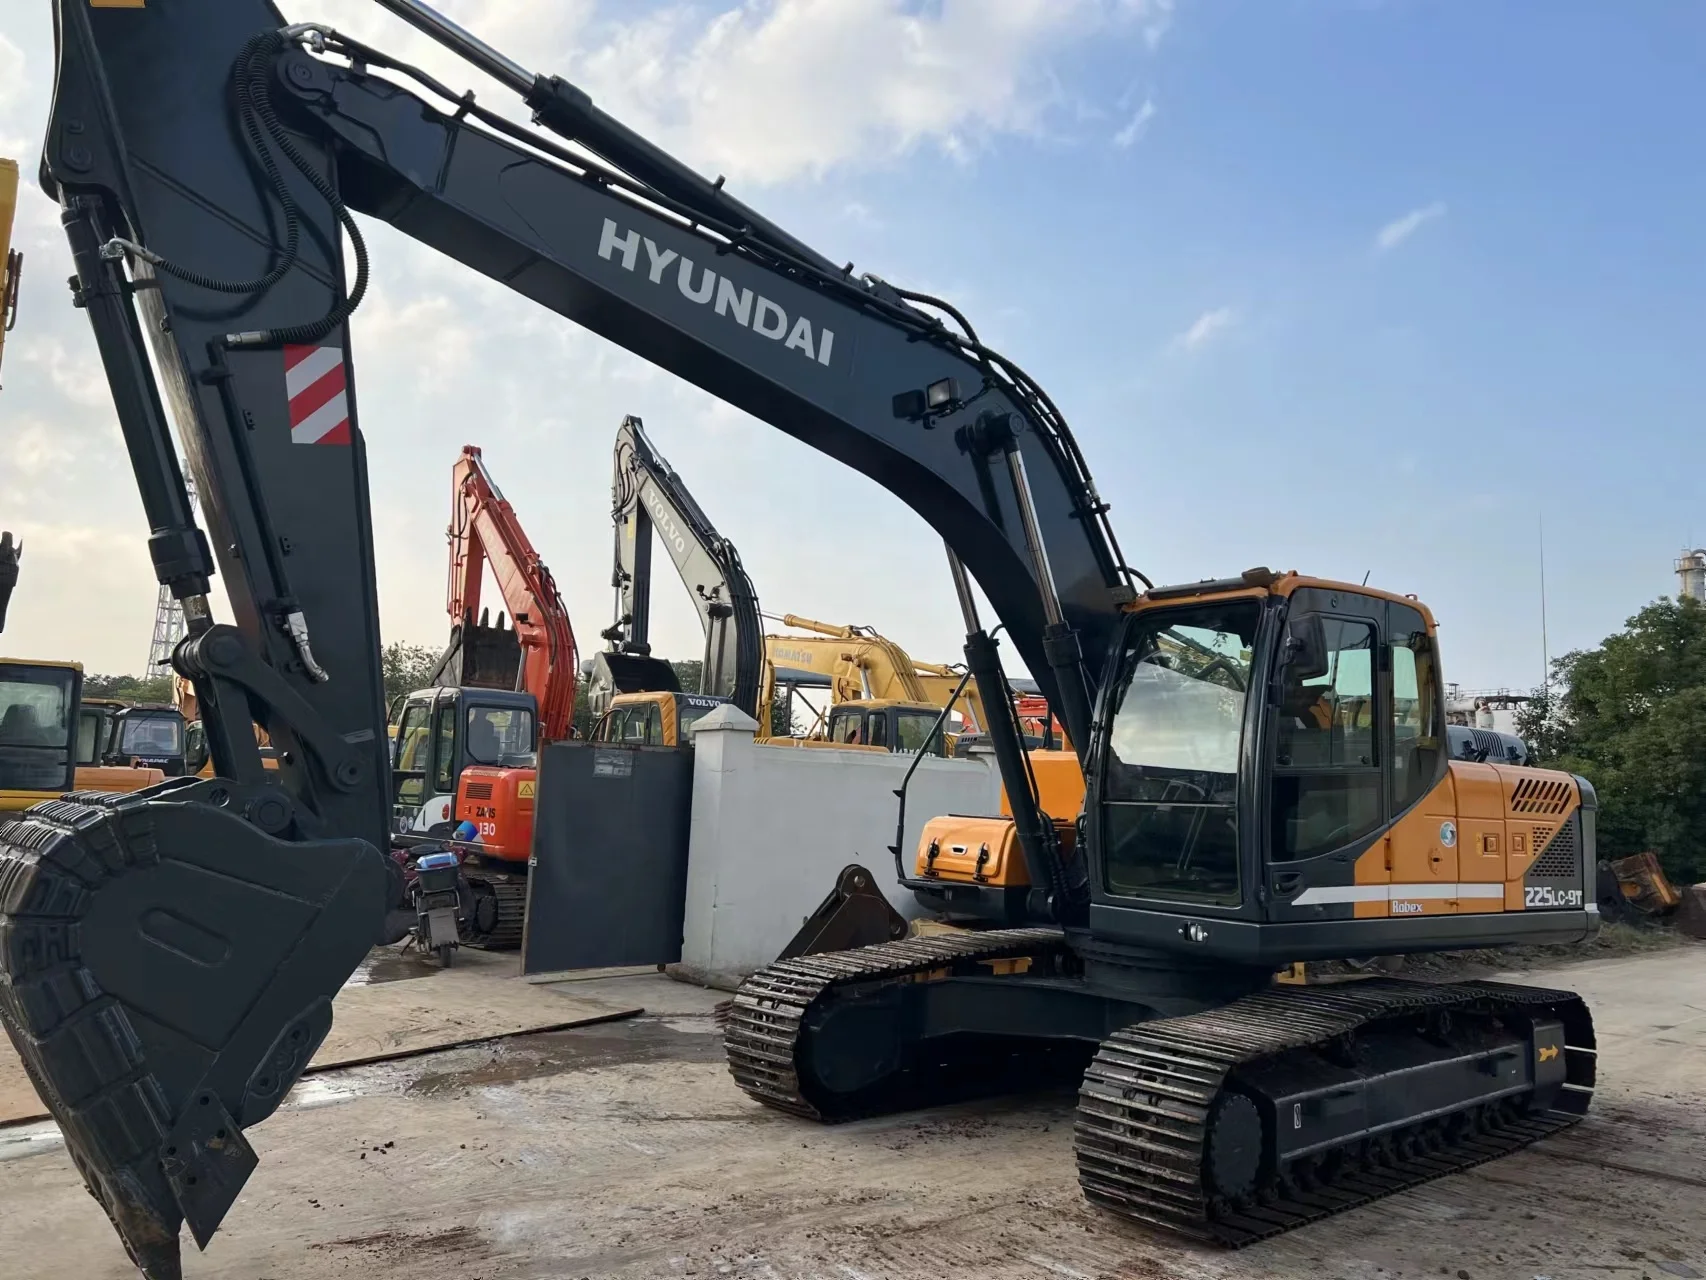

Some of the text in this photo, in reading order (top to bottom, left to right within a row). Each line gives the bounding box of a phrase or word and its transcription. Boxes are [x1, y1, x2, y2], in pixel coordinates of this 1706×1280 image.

[597, 217, 834, 367] HYUNDAI
[649, 488, 685, 553] VOLVO
[774, 647, 813, 665] KOMATSU
[687, 697, 721, 707] VOLVO
[479, 822, 496, 836] 130
[1524, 886, 1583, 907] 225LC-9T
[1392, 900, 1423, 913] Robex
